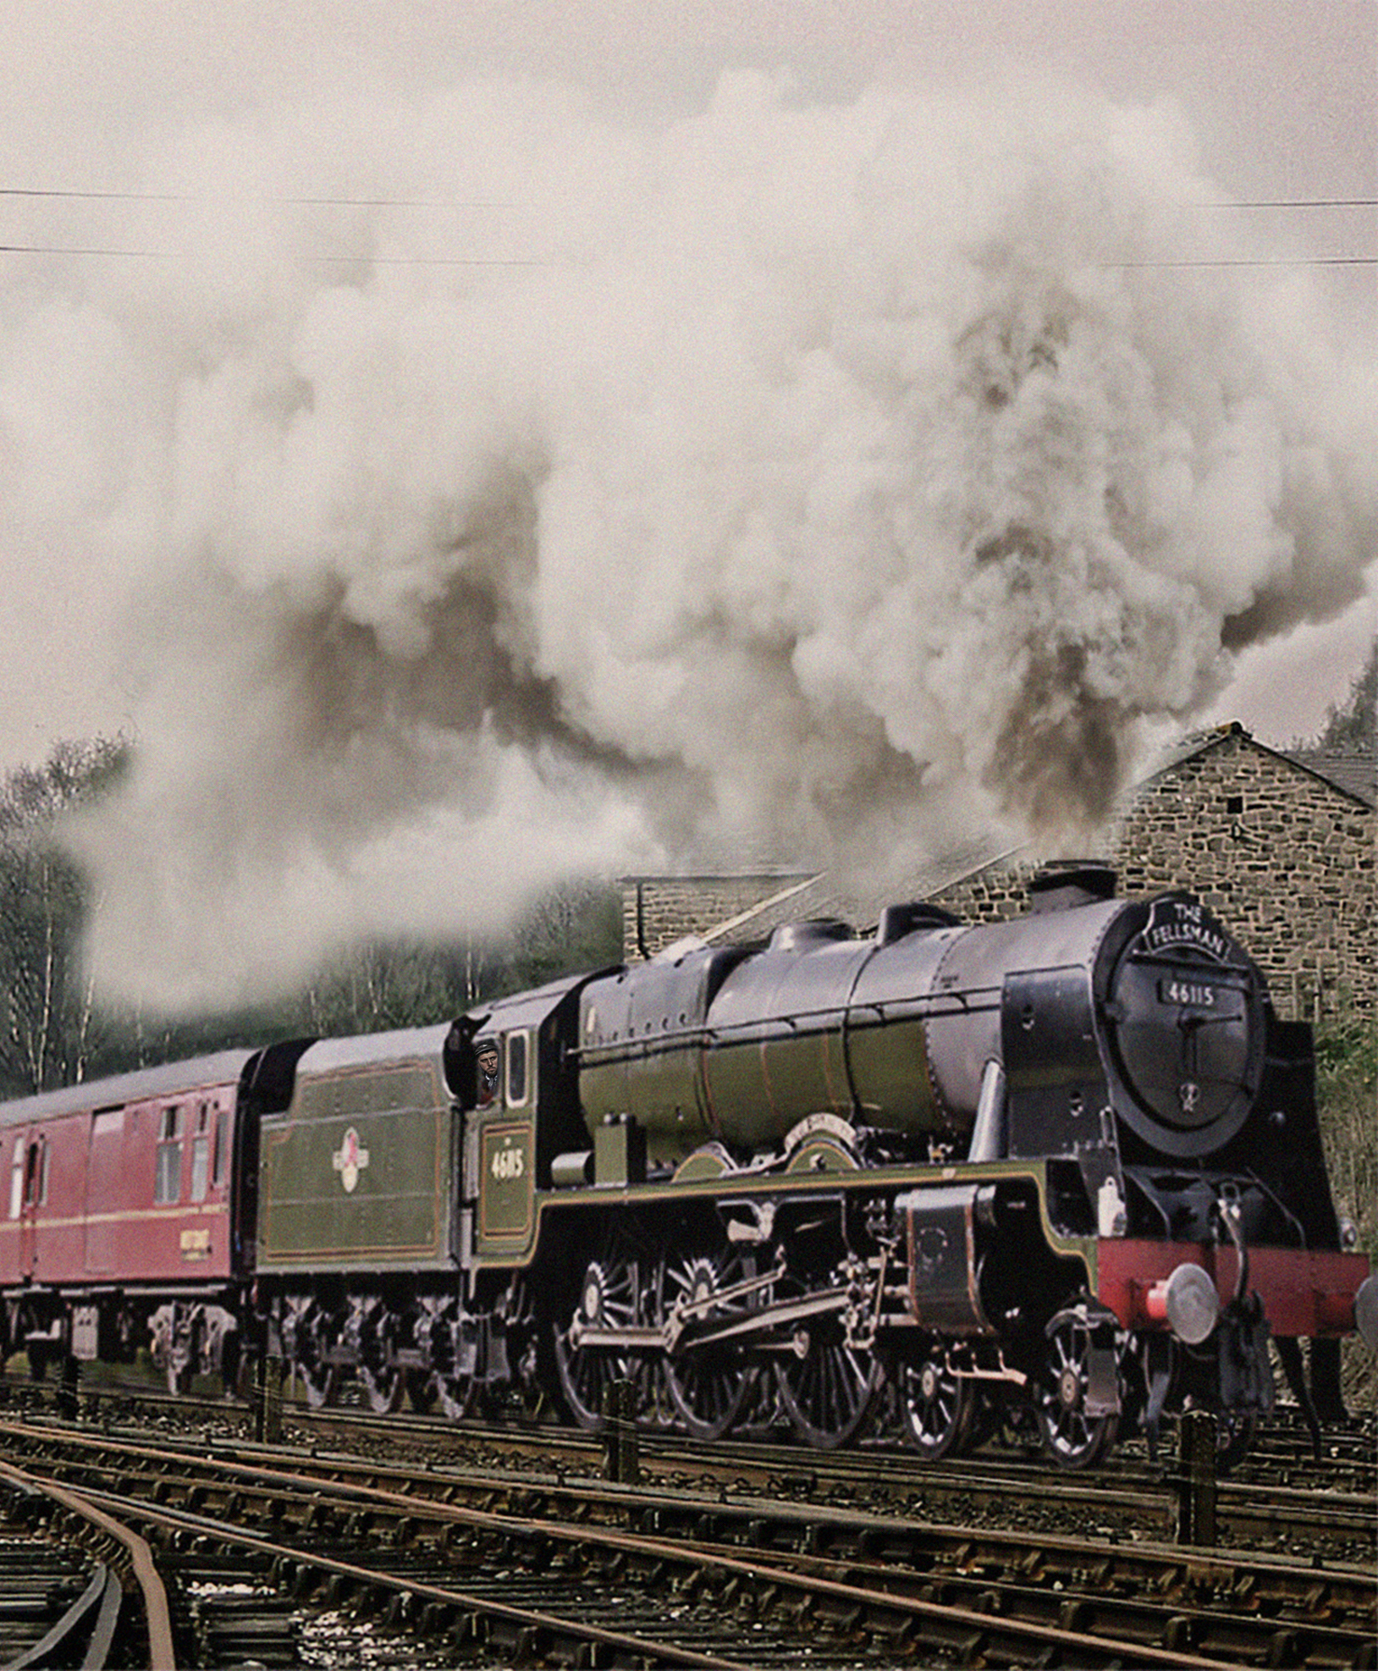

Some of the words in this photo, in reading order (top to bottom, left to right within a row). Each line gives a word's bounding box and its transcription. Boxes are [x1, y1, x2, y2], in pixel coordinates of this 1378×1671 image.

[1173, 903, 1202, 923] THE
[1152, 924, 1224, 954] FELLSMAN
[1169, 982, 1215, 1006] 46115
[491, 1148, 524, 1179] 46115
